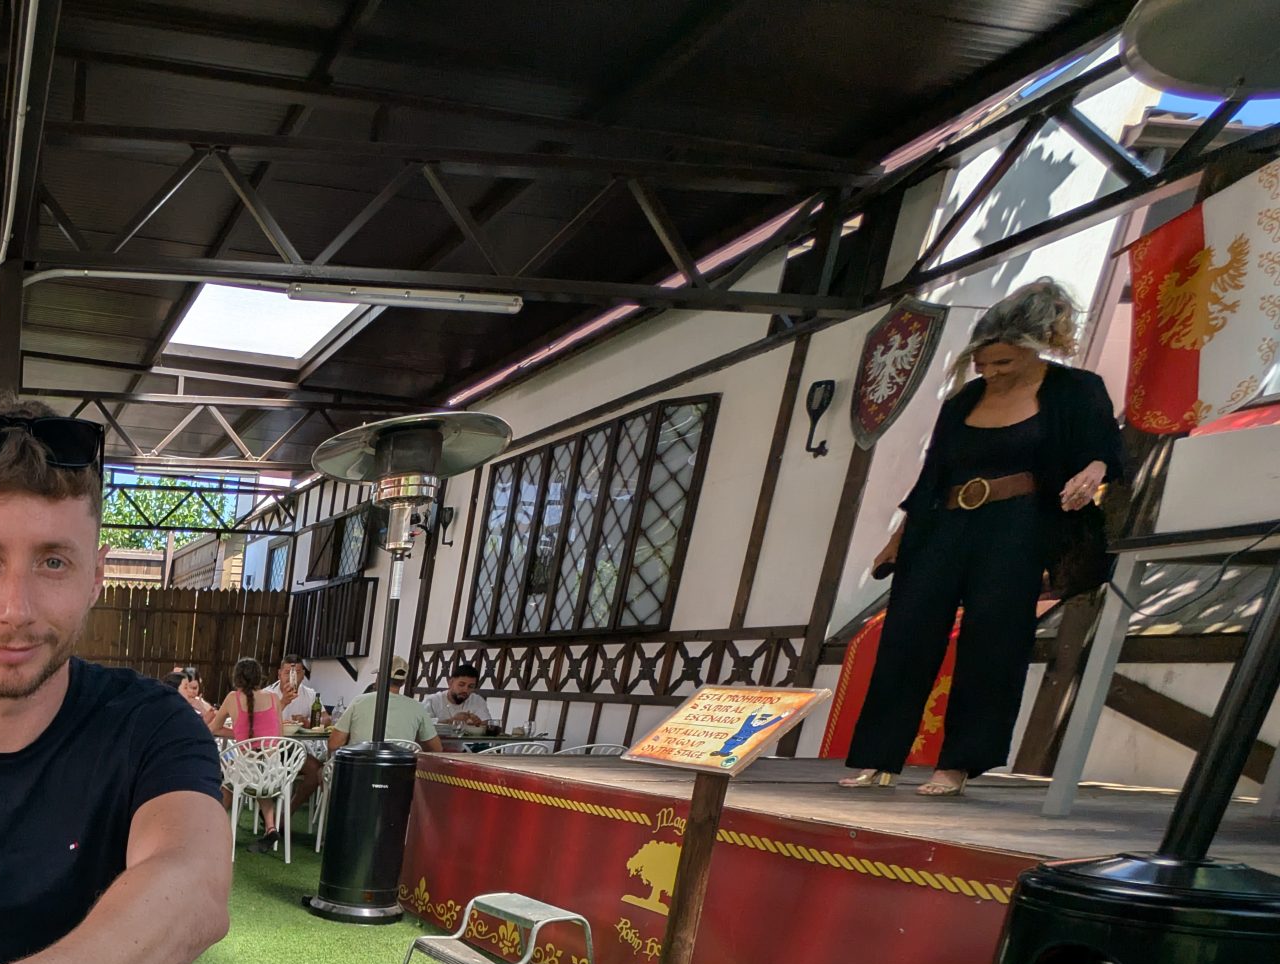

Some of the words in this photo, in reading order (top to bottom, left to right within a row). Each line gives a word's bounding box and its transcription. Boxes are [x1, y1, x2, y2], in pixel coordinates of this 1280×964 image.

[722, 693, 781, 704] PROHIBIDO
[700, 703, 732, 712] SUBIR
[731, 706, 746, 714] AL
[684, 713, 742, 724] ESCENARIO
[661, 727, 683, 735] NOT
[681, 728, 729, 740] ALLOWED
[663, 736, 677, 744] TO
[641, 744, 658, 752] ON
[657, 746, 676, 755] THE
[673, 750, 706, 758] STAGE
[652, 807, 687, 836] Mag
[614, 917, 643, 955] Robin
[642, 937, 662, 962] Ho
